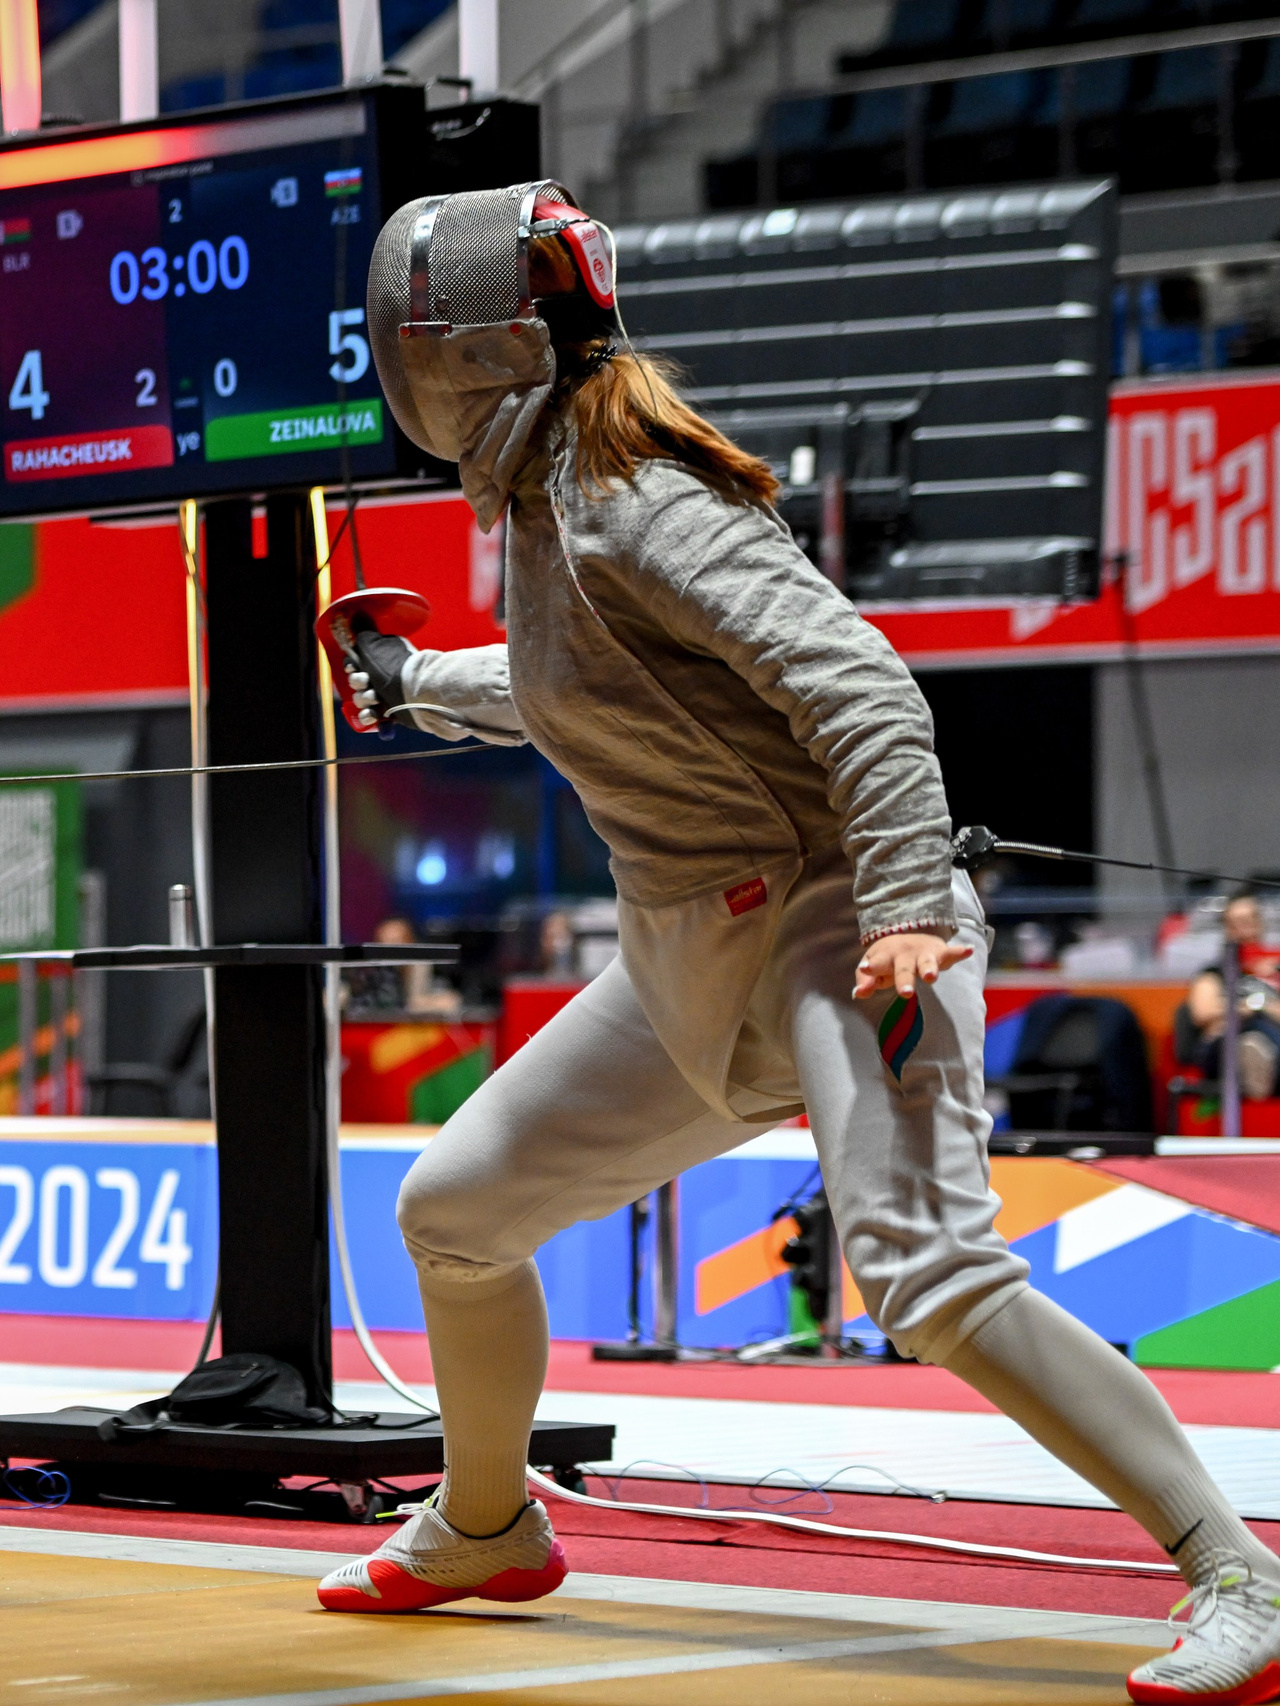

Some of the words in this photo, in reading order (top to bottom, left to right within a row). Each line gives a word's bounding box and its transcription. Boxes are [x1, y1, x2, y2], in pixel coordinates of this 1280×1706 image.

[169, 199, 182, 223] 2
[110, 235, 249, 304] 03:00
[328, 307, 370, 383] 5
[9, 350, 50, 420] 4
[135, 369, 157, 407] 2
[214, 358, 237, 397] 0
[269, 410, 376, 443] ZEINALOVA
[11, 438, 132, 472] RAHACHEUSK
